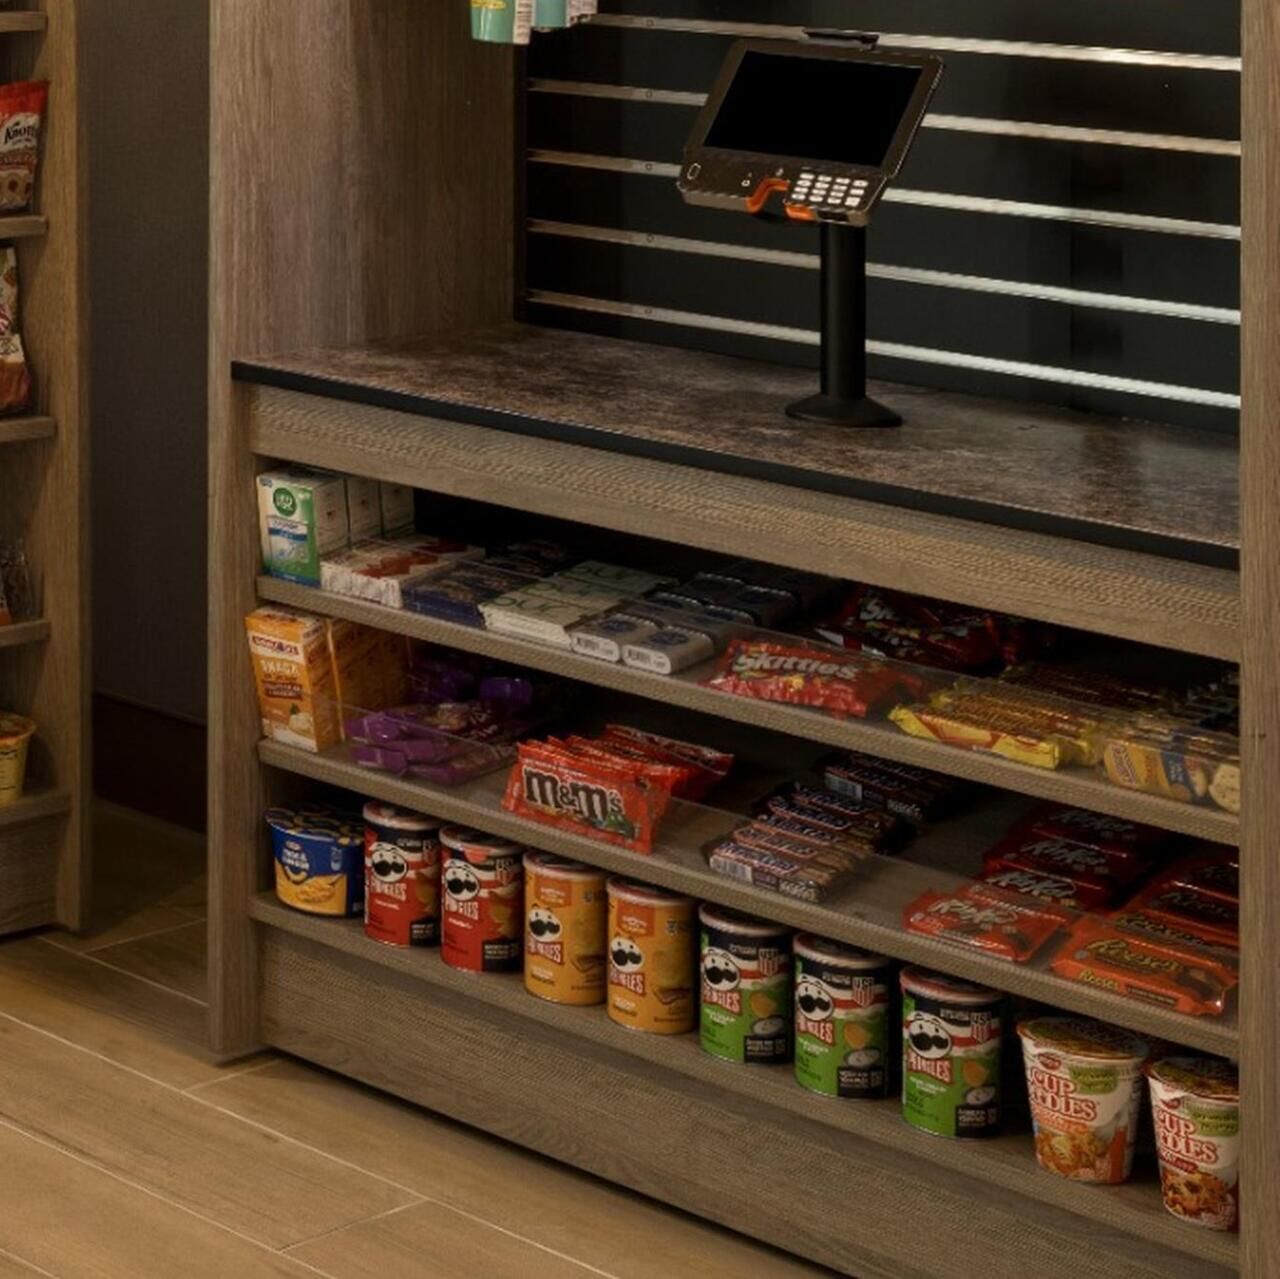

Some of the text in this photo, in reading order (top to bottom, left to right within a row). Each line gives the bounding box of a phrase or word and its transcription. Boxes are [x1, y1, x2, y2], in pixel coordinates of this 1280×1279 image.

[731, 651, 860, 682] Skittles
[522, 764, 626, 816] m&m's
[1030, 1065, 1076, 1095] CUP
